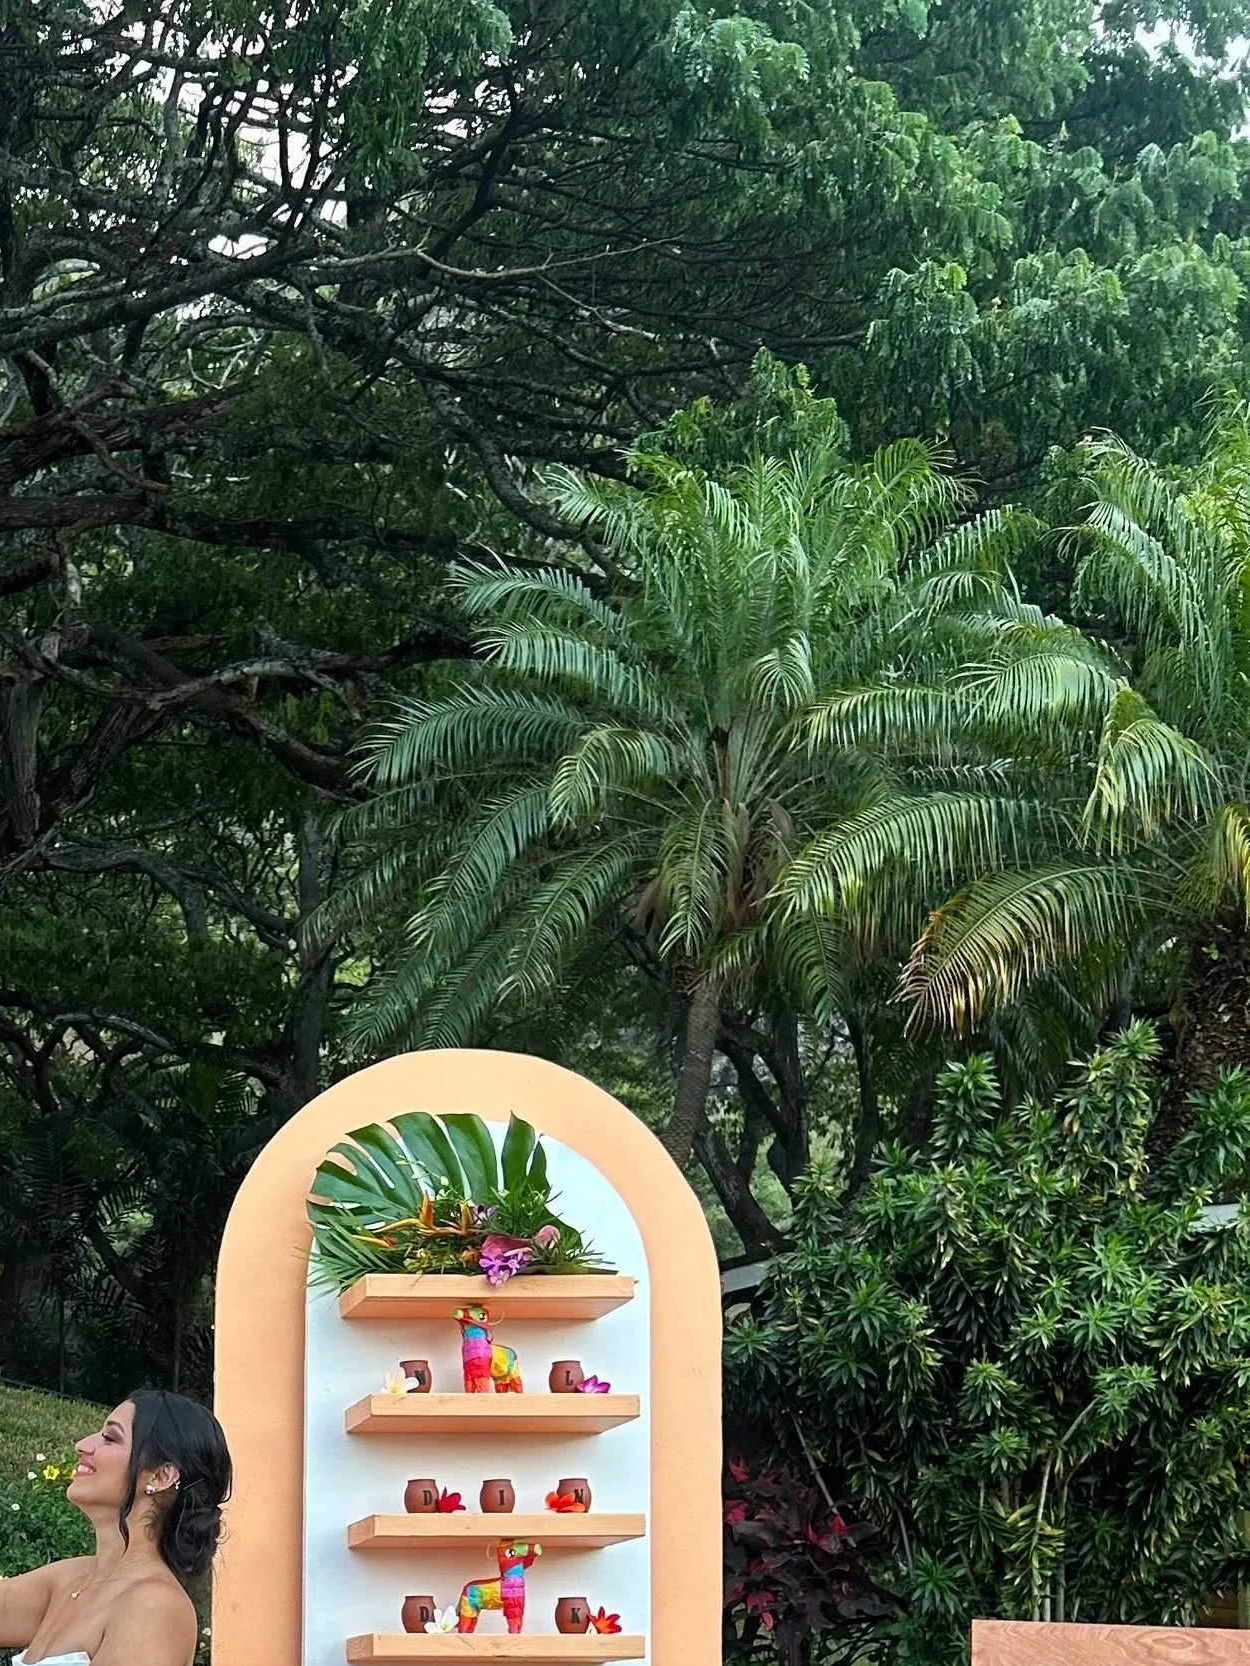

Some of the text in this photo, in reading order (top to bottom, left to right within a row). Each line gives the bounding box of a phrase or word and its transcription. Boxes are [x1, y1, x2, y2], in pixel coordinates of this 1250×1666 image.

[565, 1370, 574, 1386] L
[422, 1489, 433, 1506] D
[499, 1489, 505, 1506] I
[573, 1489, 584, 1504] N
[419, 1606, 430, 1622] D
[570, 1607, 581, 1624] K
